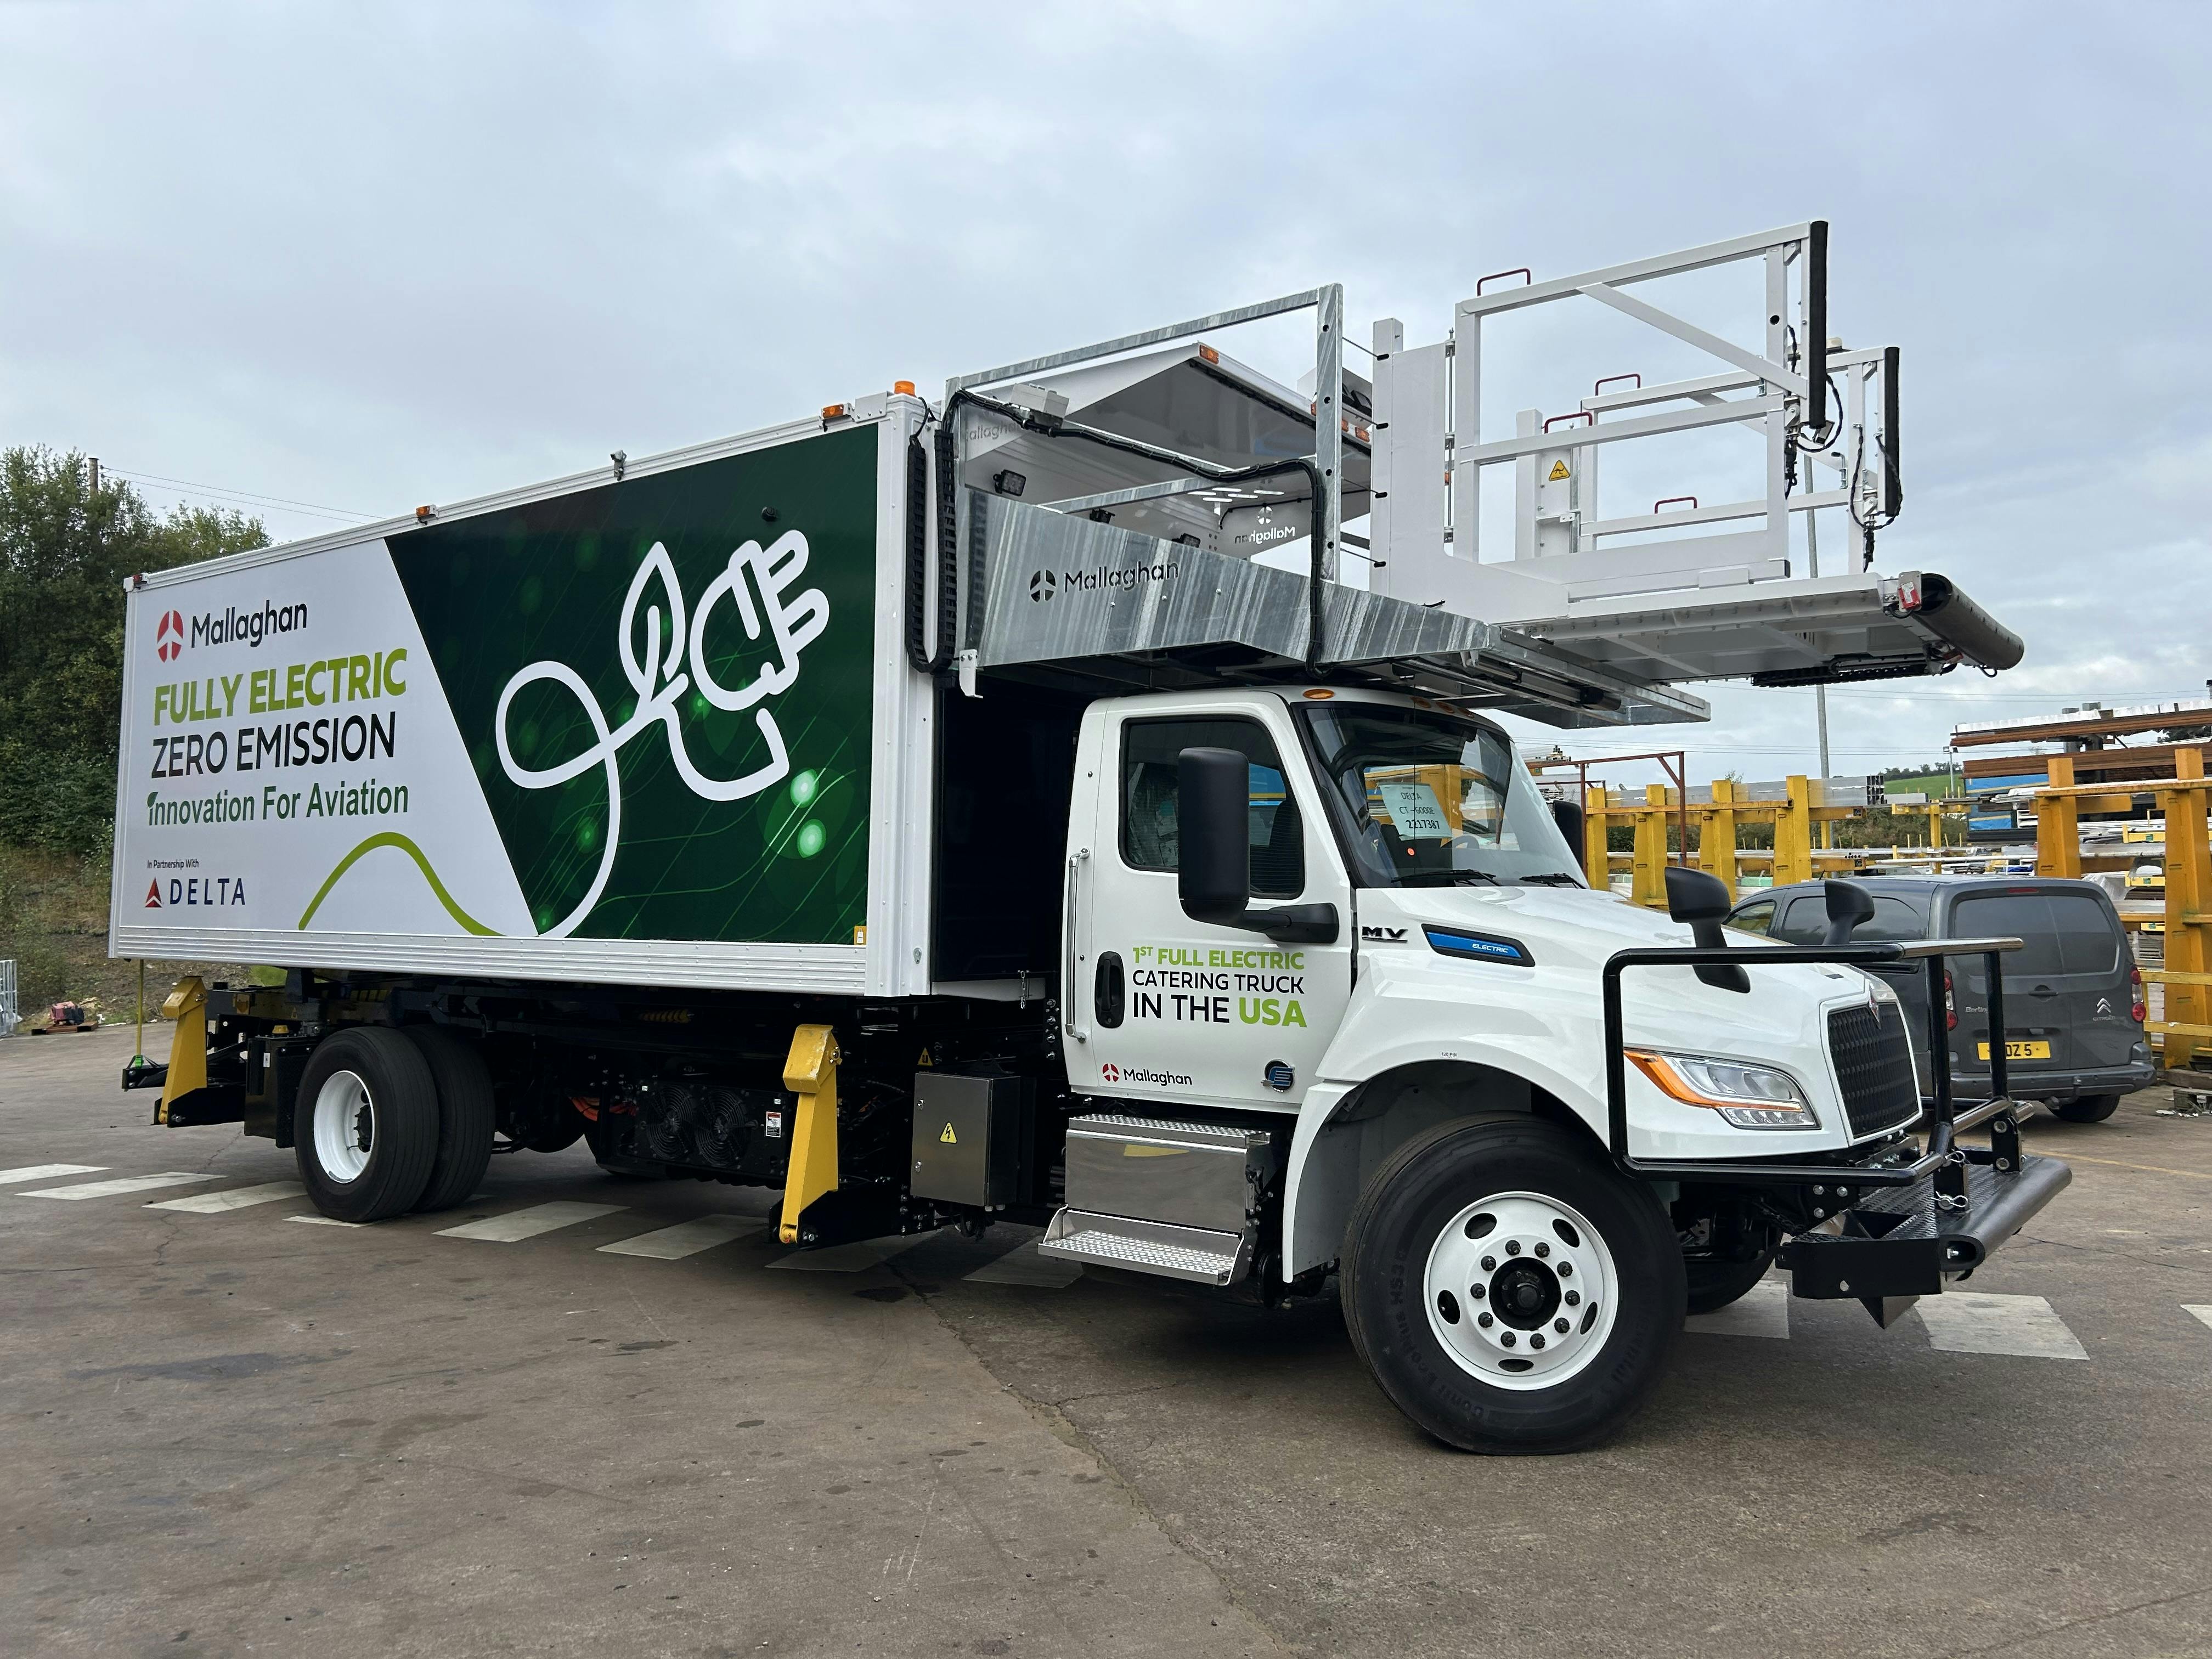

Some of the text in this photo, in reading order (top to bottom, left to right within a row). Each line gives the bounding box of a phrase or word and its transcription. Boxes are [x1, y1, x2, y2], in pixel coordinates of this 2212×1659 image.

[966, 421, 1021, 441] allagha
[1065, 561, 1178, 593] Mallaghan
[191, 600, 308, 650] Mallaghan
[154, 648, 408, 726] FULLY ELECTRIC
[151, 711, 396, 778] ZERO EMISSION
[263, 786, 301, 820] For
[306, 779, 409, 818] Aviation
[1406, 820, 1440, 829] 2217387
[147, 859, 199, 870] In Partnership With
[170, 878, 245, 905] DELTA
[1362, 926, 1408, 939] MV
[1158, 948, 1204, 967] FULL
[1209, 950, 1305, 969] ELECTRIC
[1472, 943, 1509, 953] ELECTRIC
[1132, 969, 1305, 994] CATERING TRUCK
[1133, 992, 1307, 1028] IN THE USA
[2024, 1044, 2033, 1056] 5
[1123, 1068, 1192, 1086] Mallaghan
